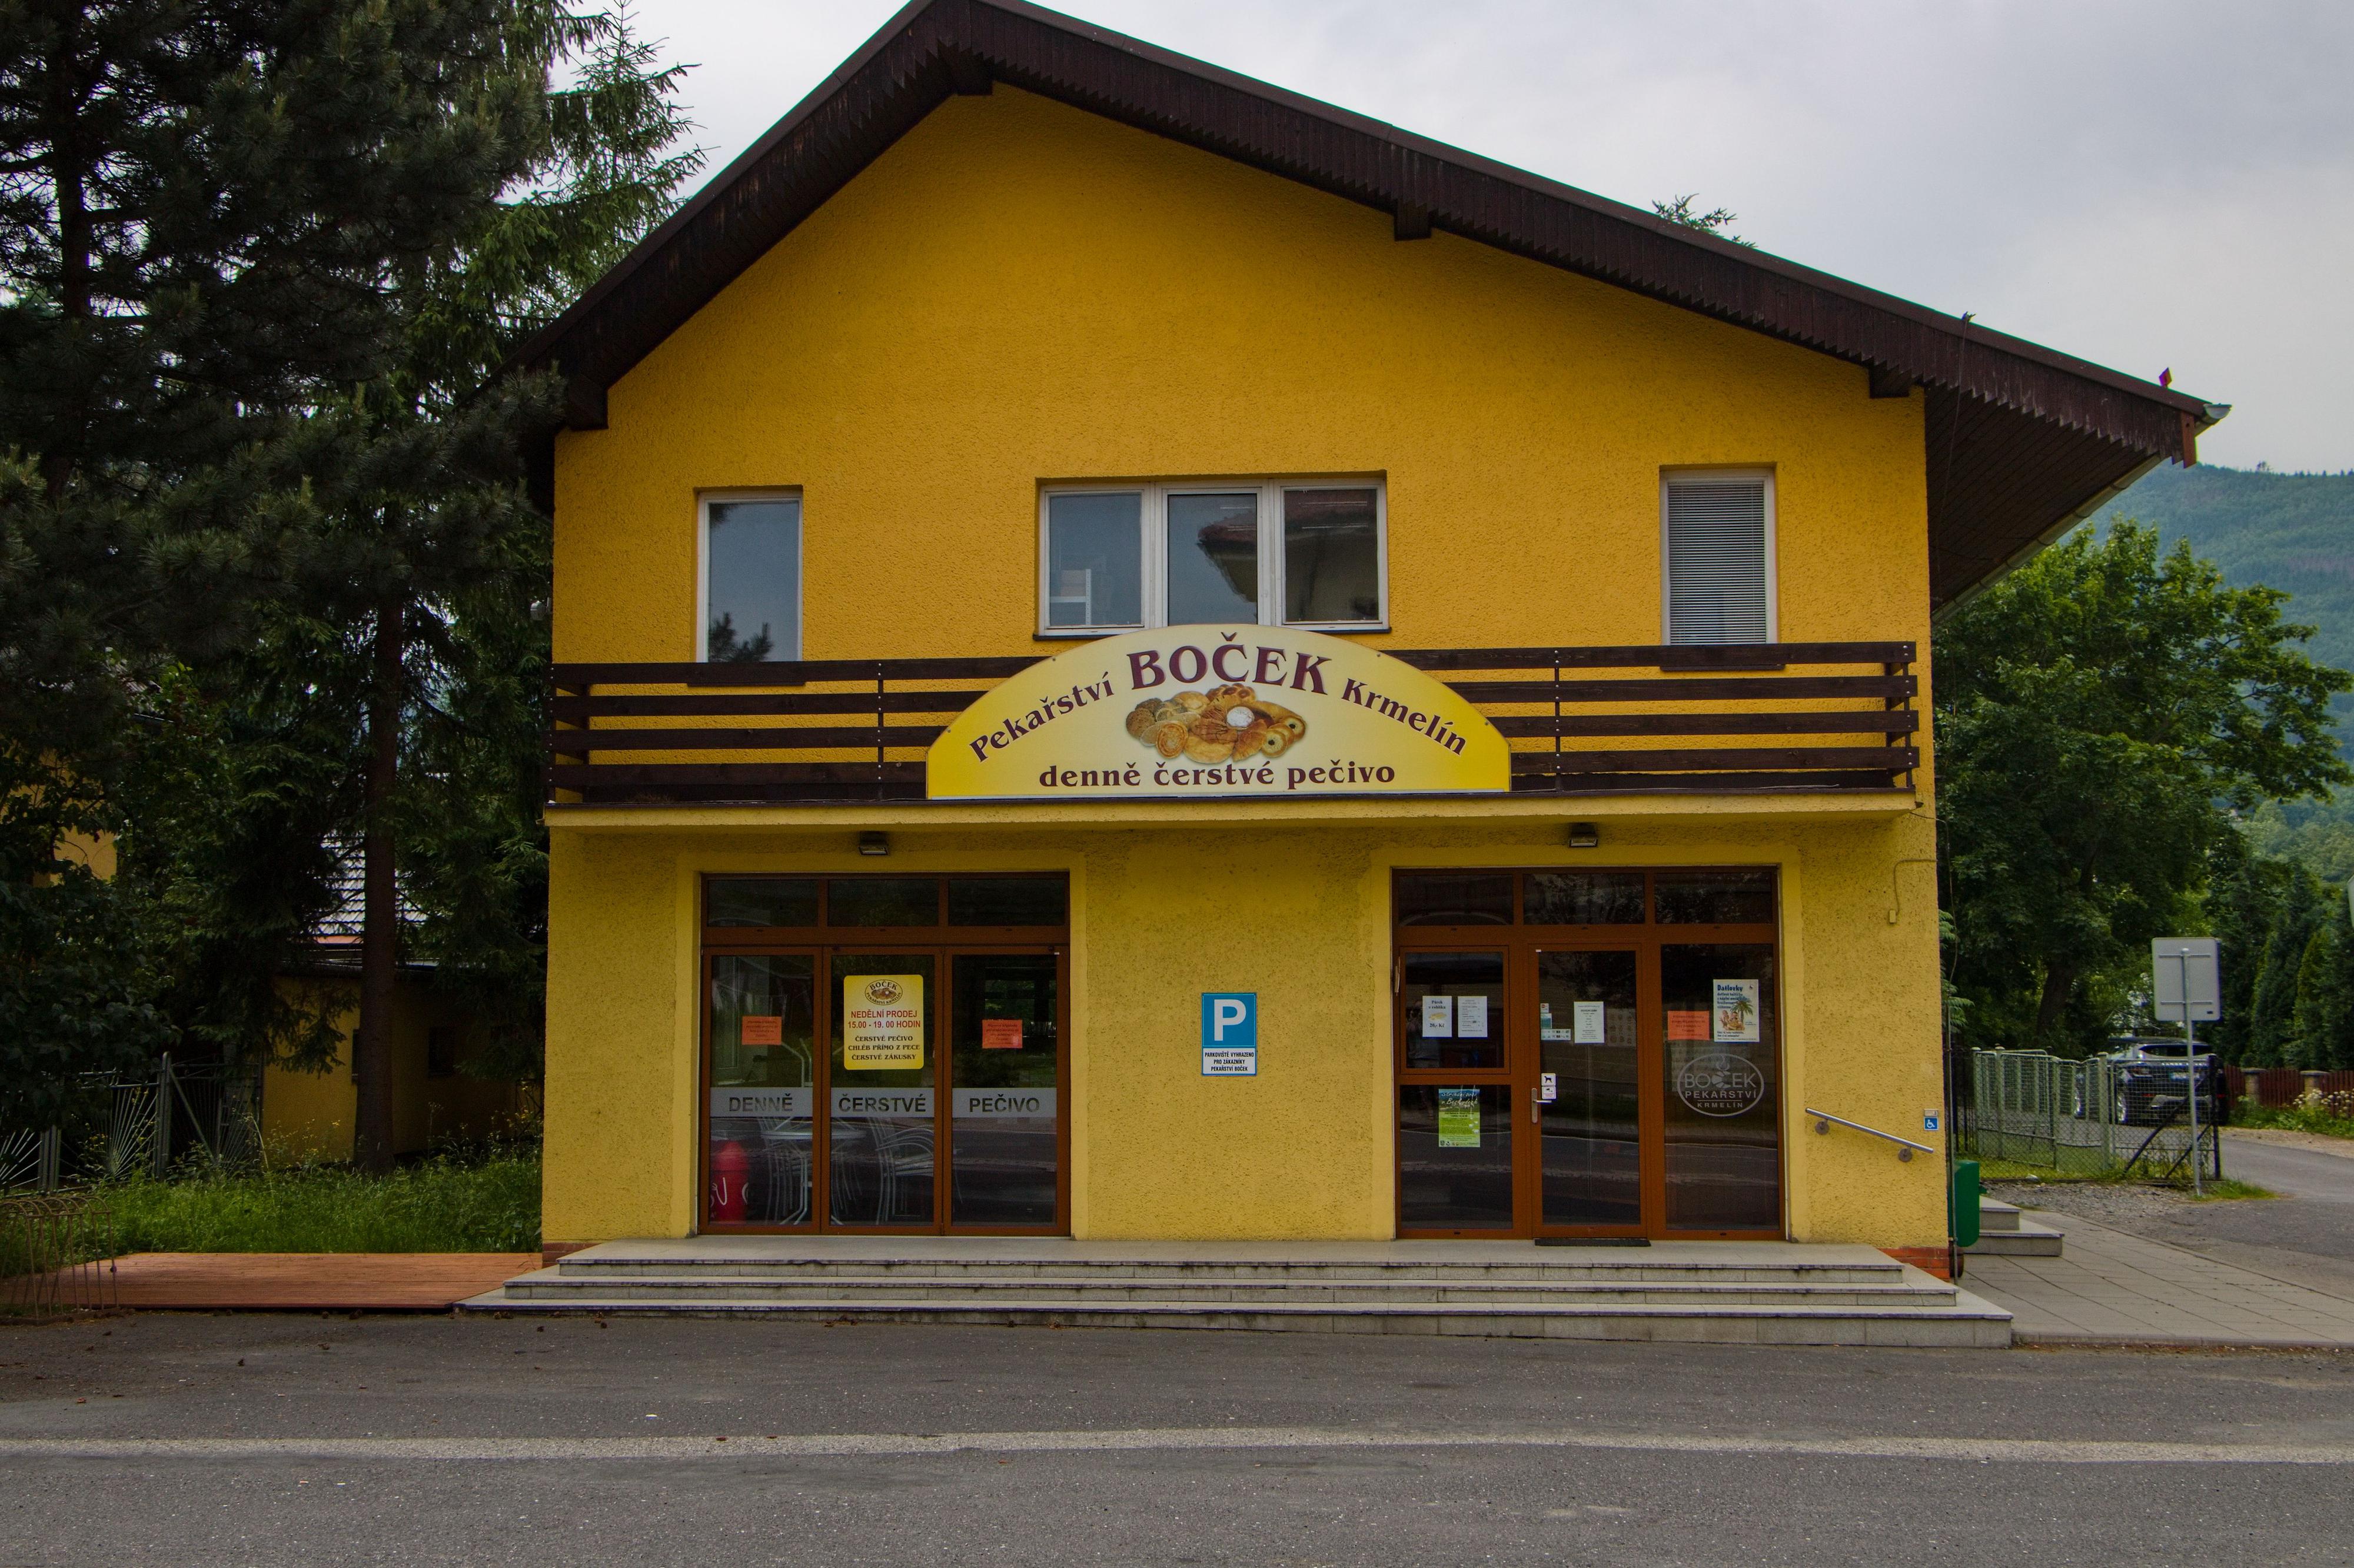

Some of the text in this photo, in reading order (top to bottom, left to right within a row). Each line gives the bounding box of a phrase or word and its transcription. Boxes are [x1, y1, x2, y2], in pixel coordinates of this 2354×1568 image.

[969, 631, 1467, 763] Pekařství BOČEK Krmelín
[1039, 760, 1395, 790] denně čerstvé pečivo
[851, 1009, 884, 1018] NEDĚLNÍ
[1214, 999, 1246, 1041] P
[729, 1093, 1040, 1113] DENNĚ ČERSTVÉ PEČIVO
[1685, 1090, 1757, 1098] PEKAŘSTVÍ
